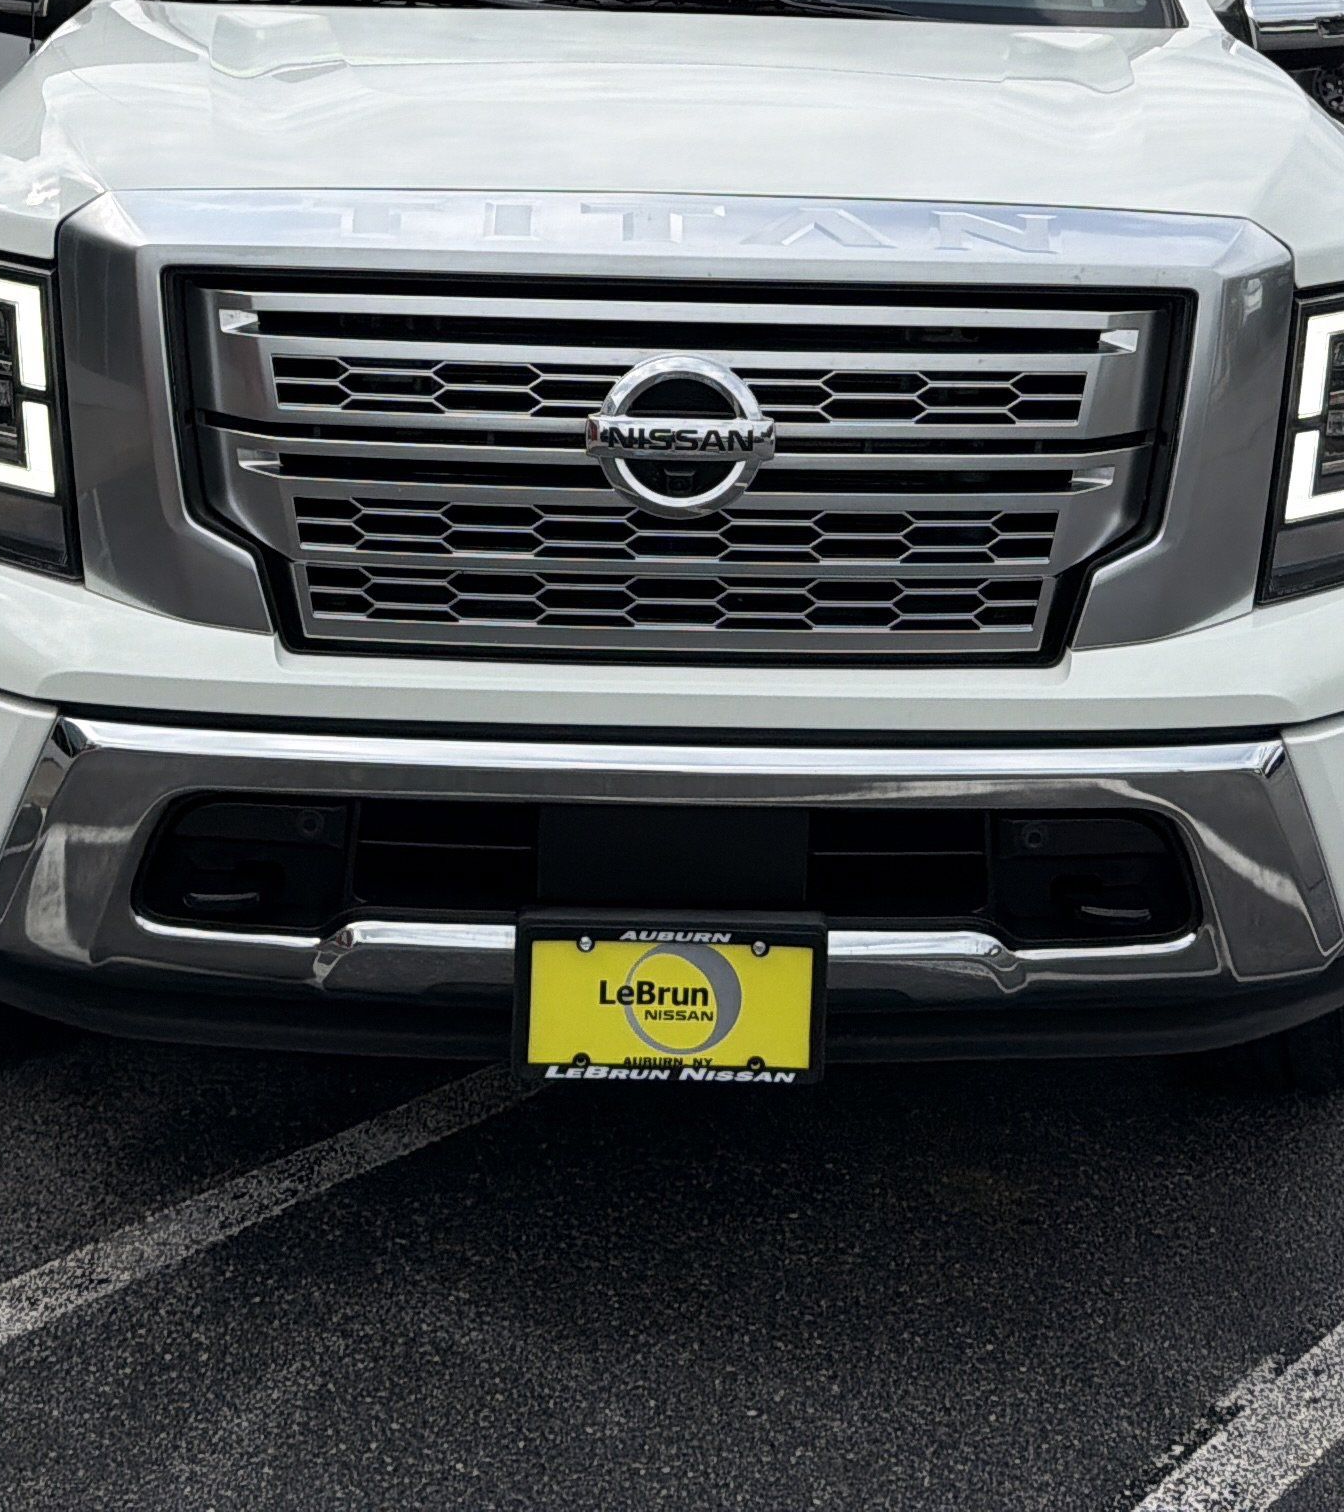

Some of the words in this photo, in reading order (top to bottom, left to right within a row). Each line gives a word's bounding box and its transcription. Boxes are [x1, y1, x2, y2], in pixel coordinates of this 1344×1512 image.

[306, 199, 1061, 255] TITAN
[607, 425, 755, 452] NISSAN
[619, 930, 732, 943] AUBURN
[599, 979, 709, 1007] LeBrun
[644, 1009, 714, 1022] NISSAN
